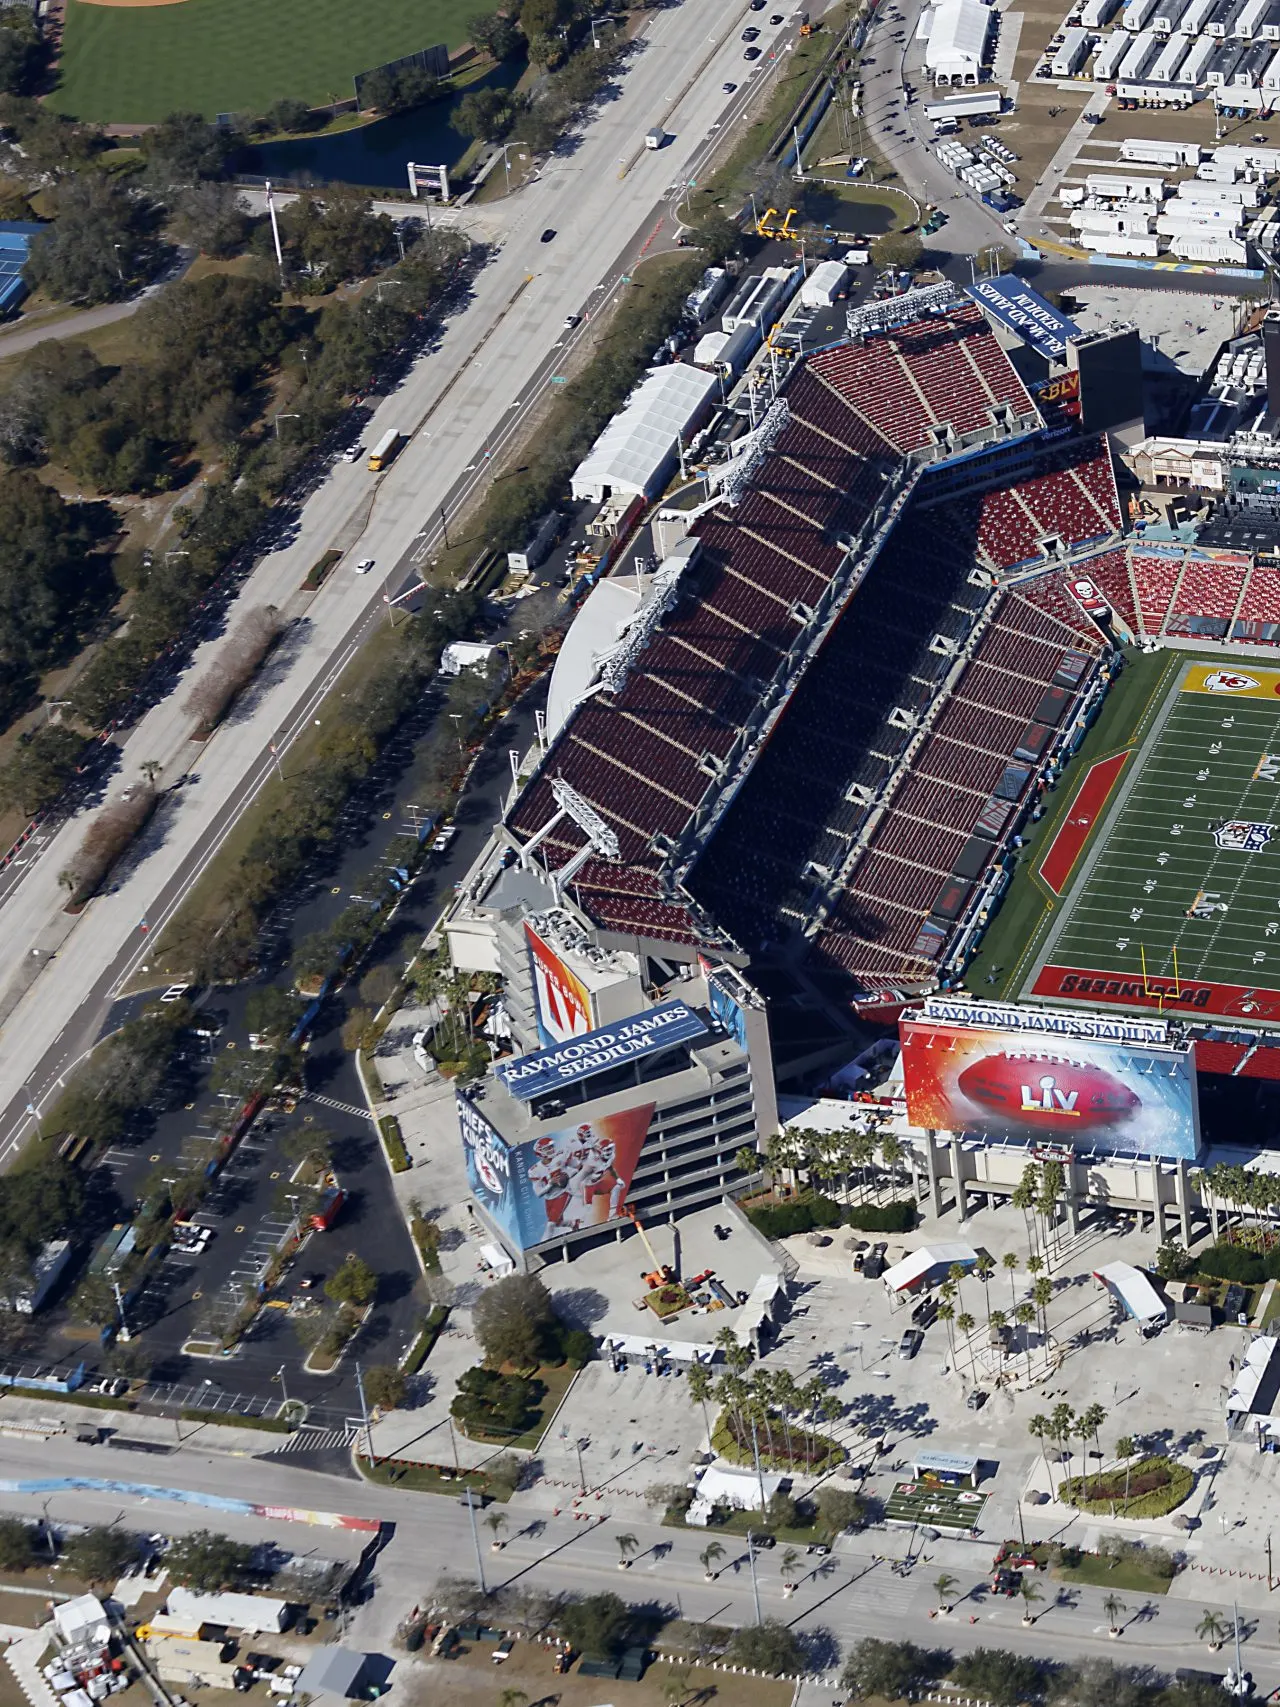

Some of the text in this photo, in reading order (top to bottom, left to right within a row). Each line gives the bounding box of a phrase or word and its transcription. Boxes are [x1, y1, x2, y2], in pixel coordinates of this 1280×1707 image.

[975, 283, 1067, 353] RAYMOND JAMES
[1011, 293, 1064, 331] STADIUM
[1221, 716, 1235, 728] 10
[1208, 742, 1222, 755] 20
[1195, 769, 1210, 781] 30
[1182, 796, 1196, 808] 40
[1169, 824, 1184, 836] 50
[1156, 852, 1171, 864] 40
[1143, 879, 1157, 891] 30
[1129, 907, 1144, 920] 20
[1265, 922, 1279, 936] 20
[532, 951, 590, 1020] SUPER BOWL
[1059, 973, 1214, 1008] BUCCANEERS
[929, 1005, 1162, 1042] RAYMOND JAMES STADIUM
[502, 1006, 689, 1082] RAYMOND JAMES
[557, 1034, 655, 1078] STADIUM
[456, 1099, 493, 1144] CHIEFS
[462, 1122, 511, 1178] KINGDOM
[515, 1150, 527, 1186] KANSAS
